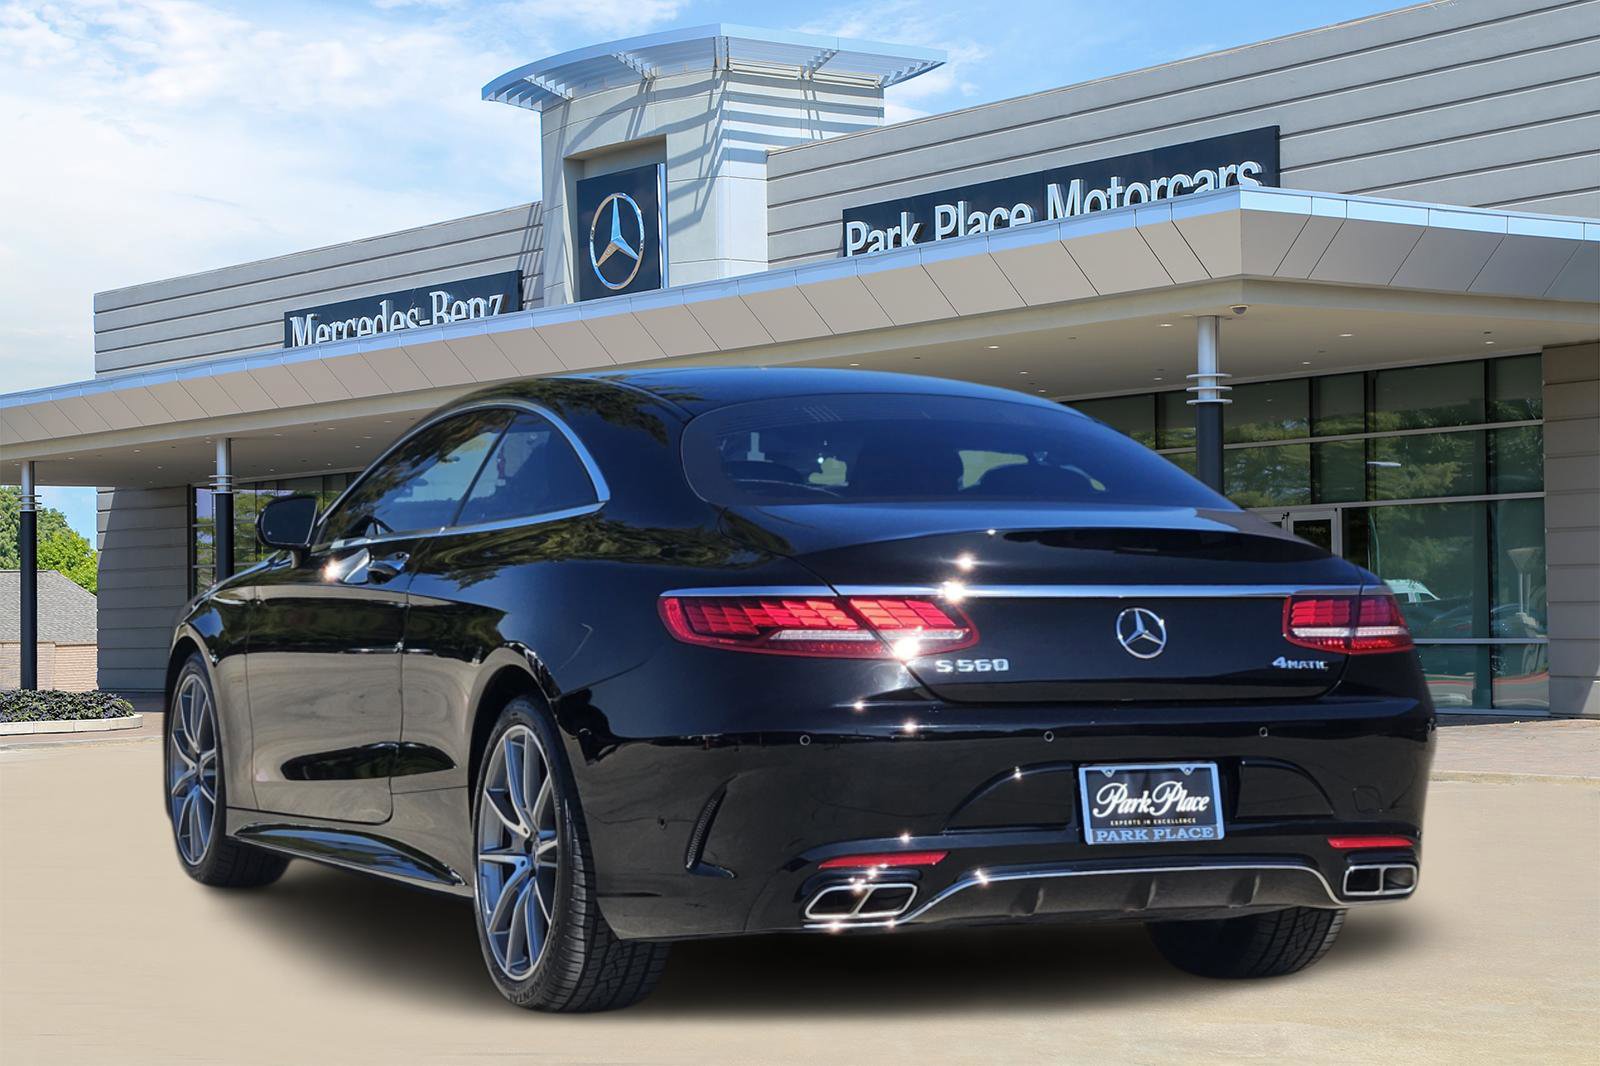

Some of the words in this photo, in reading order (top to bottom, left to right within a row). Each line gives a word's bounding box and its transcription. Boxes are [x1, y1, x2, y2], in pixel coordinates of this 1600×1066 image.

[846, 211, 921, 257] Park
[935, 200, 1033, 241] Place
[1047, 161, 1262, 221] Motorcars
[290, 290, 504, 347] Mercedes-Benz
[935, 659, 954, 673] S
[956, 658, 1009, 673] 560
[1272, 656, 1329, 670] 4MATIC
[1092, 782, 1151, 818] Park
[1150, 780, 1210, 816] Place
[1095, 829, 1149, 842] PARK
[1152, 827, 1215, 840] PLACE
